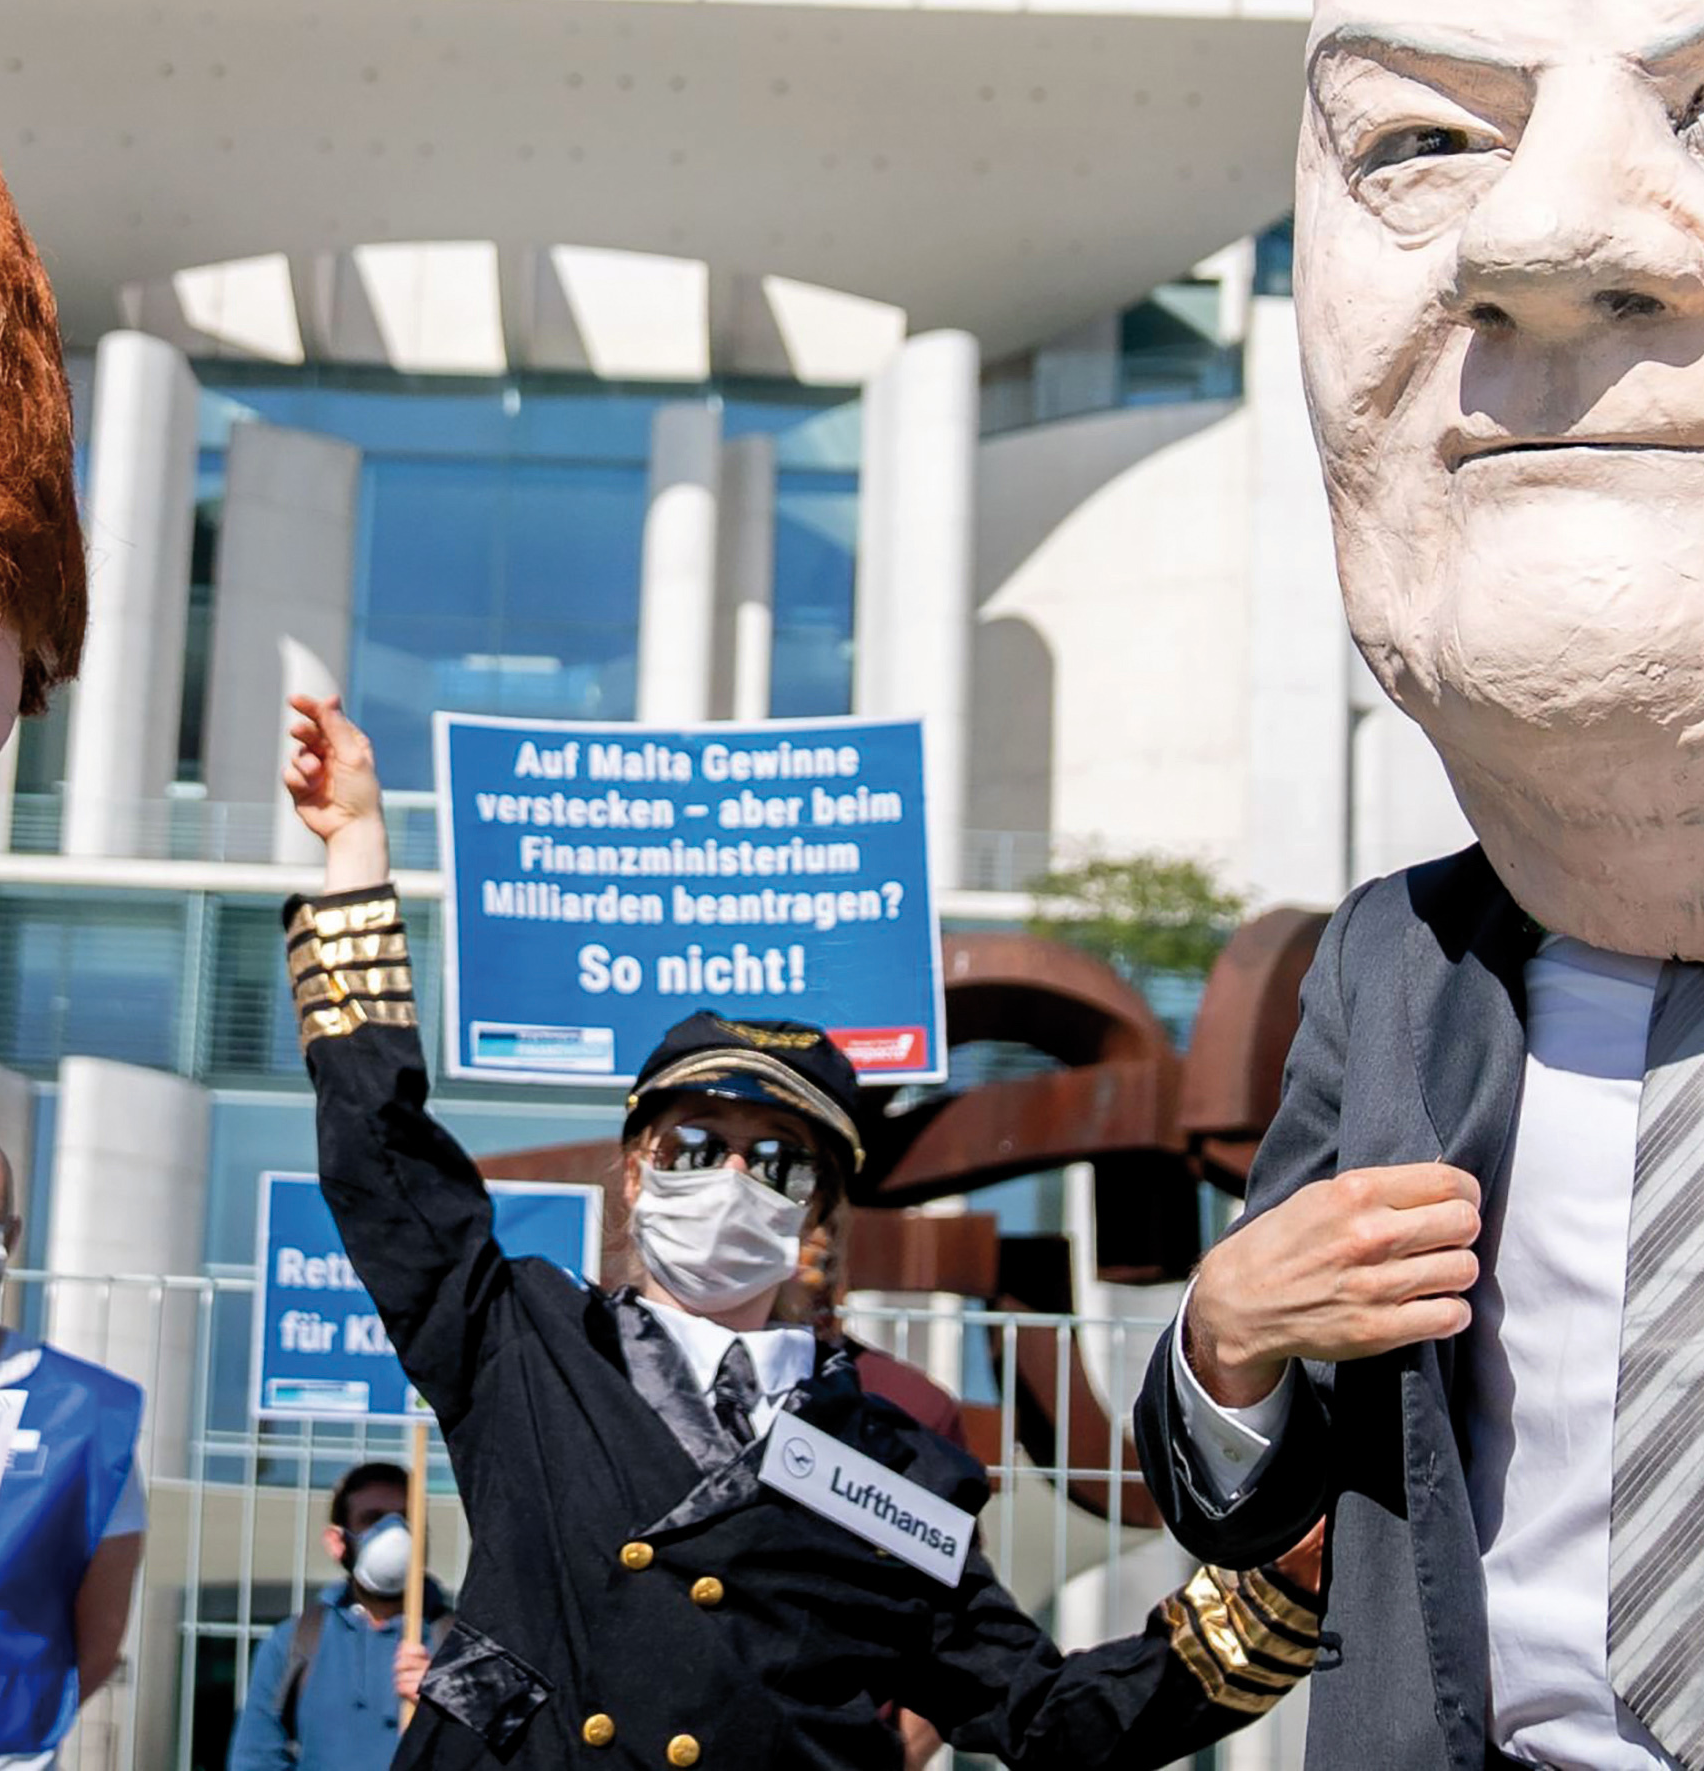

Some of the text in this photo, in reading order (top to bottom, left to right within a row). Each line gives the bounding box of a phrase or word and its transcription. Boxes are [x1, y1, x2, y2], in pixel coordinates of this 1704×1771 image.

[514, 741, 859, 782] Auf Malta Gewinne
[477, 790, 674, 828] verstecken
[719, 790, 803, 828] aber
[812, 786, 902, 824] beim
[520, 835, 860, 876] Finanzministerium
[483, 880, 904, 931] Milliarden beantragen?
[578, 944, 806, 993] So nicht!
[277, 1247, 364, 1290] Rett
[280, 1310, 338, 1352] für
[831, 1466, 957, 1558] Lufthansa
